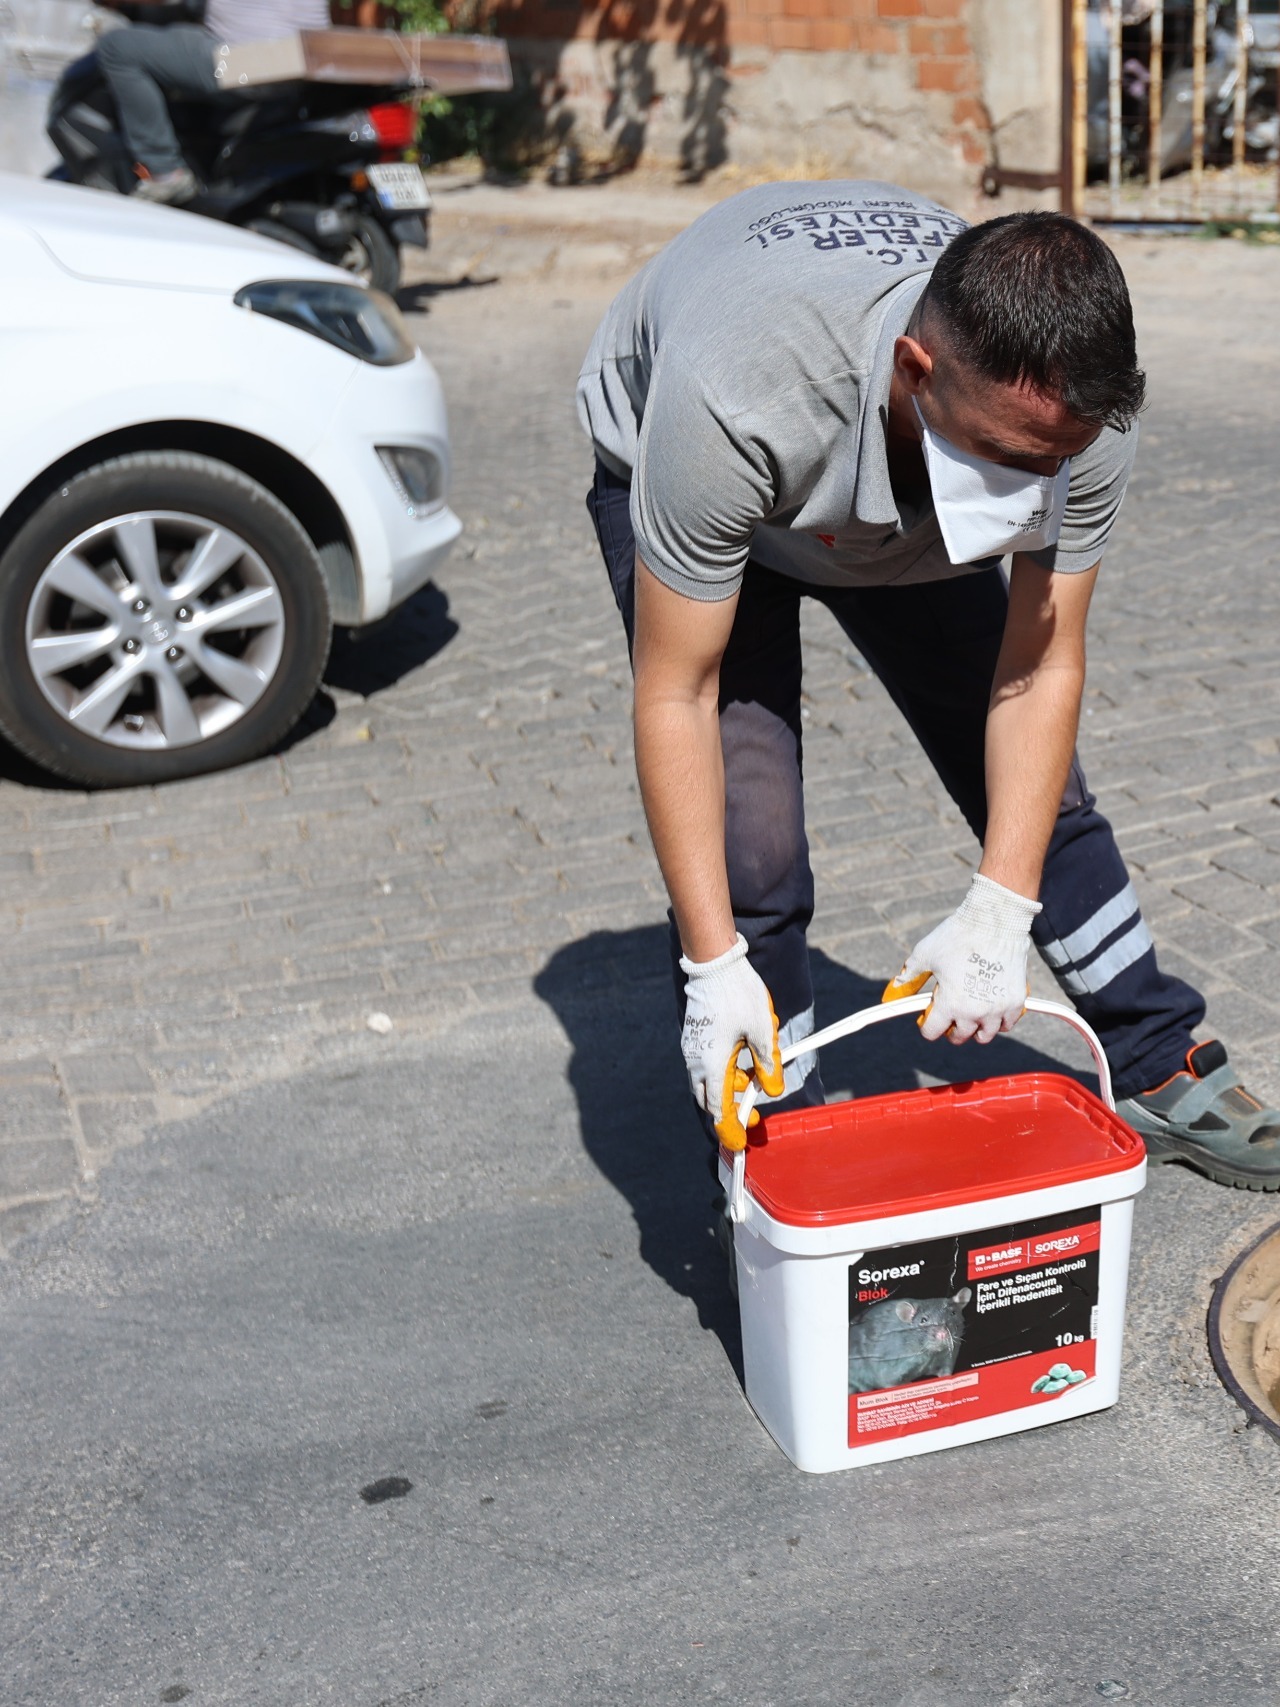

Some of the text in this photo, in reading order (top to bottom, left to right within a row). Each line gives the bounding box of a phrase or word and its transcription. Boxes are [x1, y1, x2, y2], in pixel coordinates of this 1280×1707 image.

[991, 1235, 1080, 1262] BASF SOREXA
[977, 1259, 1087, 1293] Fare ve Sıçan Kontrolü
[998, 1278, 1057, 1297] Difenacoum
[858, 1287, 889, 1302] Blok
[976, 1284, 1063, 1314] İçerikli Rodentisit
[1055, 1332, 1085, 1347] 10 kg
